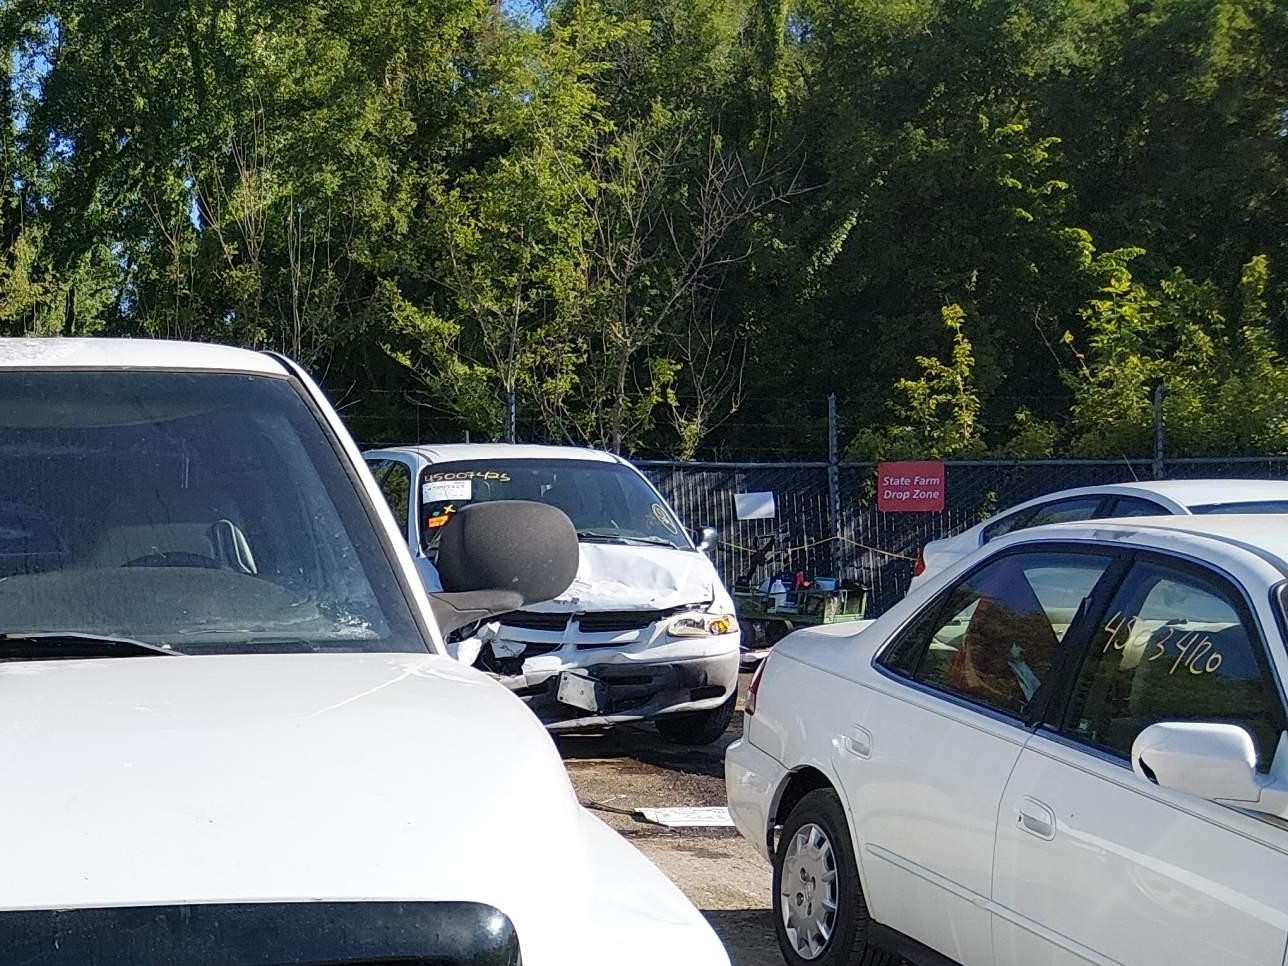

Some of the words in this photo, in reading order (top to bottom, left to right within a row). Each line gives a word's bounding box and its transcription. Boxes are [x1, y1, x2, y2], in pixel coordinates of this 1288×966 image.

[882, 476, 911, 486] State
[913, 476, 940, 486] Farm
[883, 490, 910, 501] Drop
[912, 490, 940, 499] Zone
